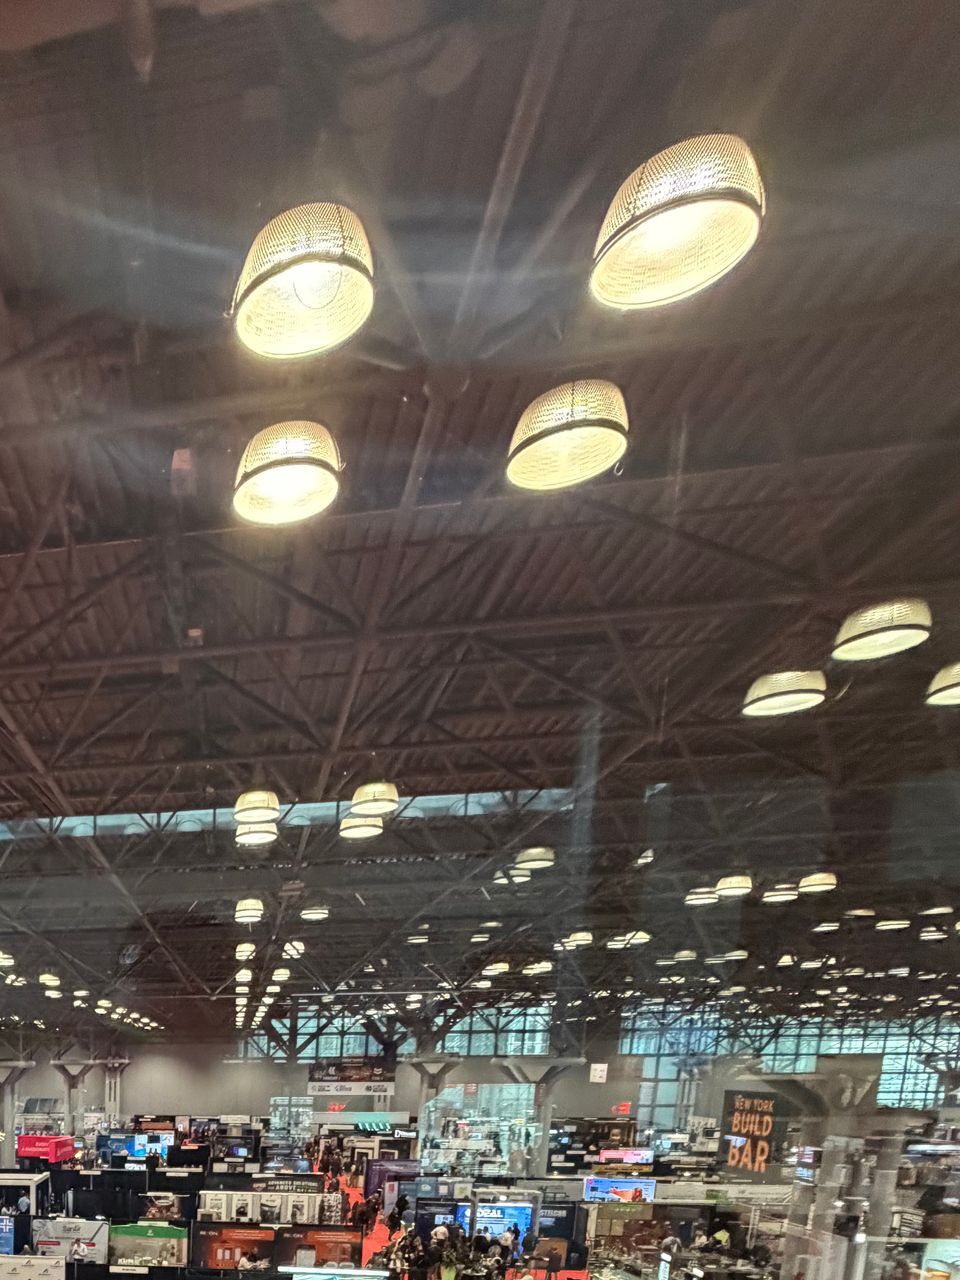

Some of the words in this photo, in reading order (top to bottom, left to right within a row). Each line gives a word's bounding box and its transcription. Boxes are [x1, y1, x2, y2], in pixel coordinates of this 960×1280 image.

[734, 1098, 753, 1110] NEW
[754, 1100, 775, 1112] YORK
[731, 1111, 773, 1137] BUILD
[727, 1138, 770, 1173] BAR
